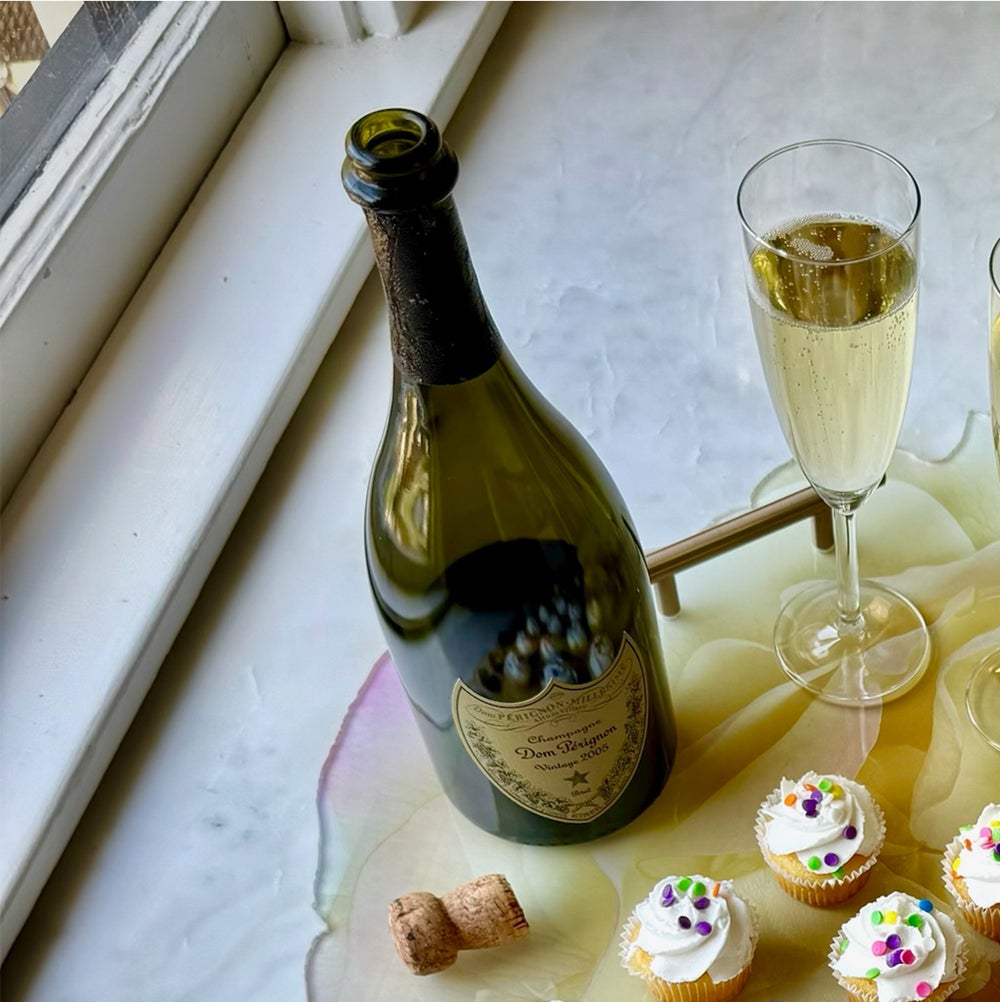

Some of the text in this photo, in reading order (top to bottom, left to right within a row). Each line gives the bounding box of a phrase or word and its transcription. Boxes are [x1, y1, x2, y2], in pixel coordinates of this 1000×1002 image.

[514, 725, 617, 760] Dom Pérignon
[527, 719, 602, 744] Champagne
[534, 743, 609, 772] Vintage 2005
